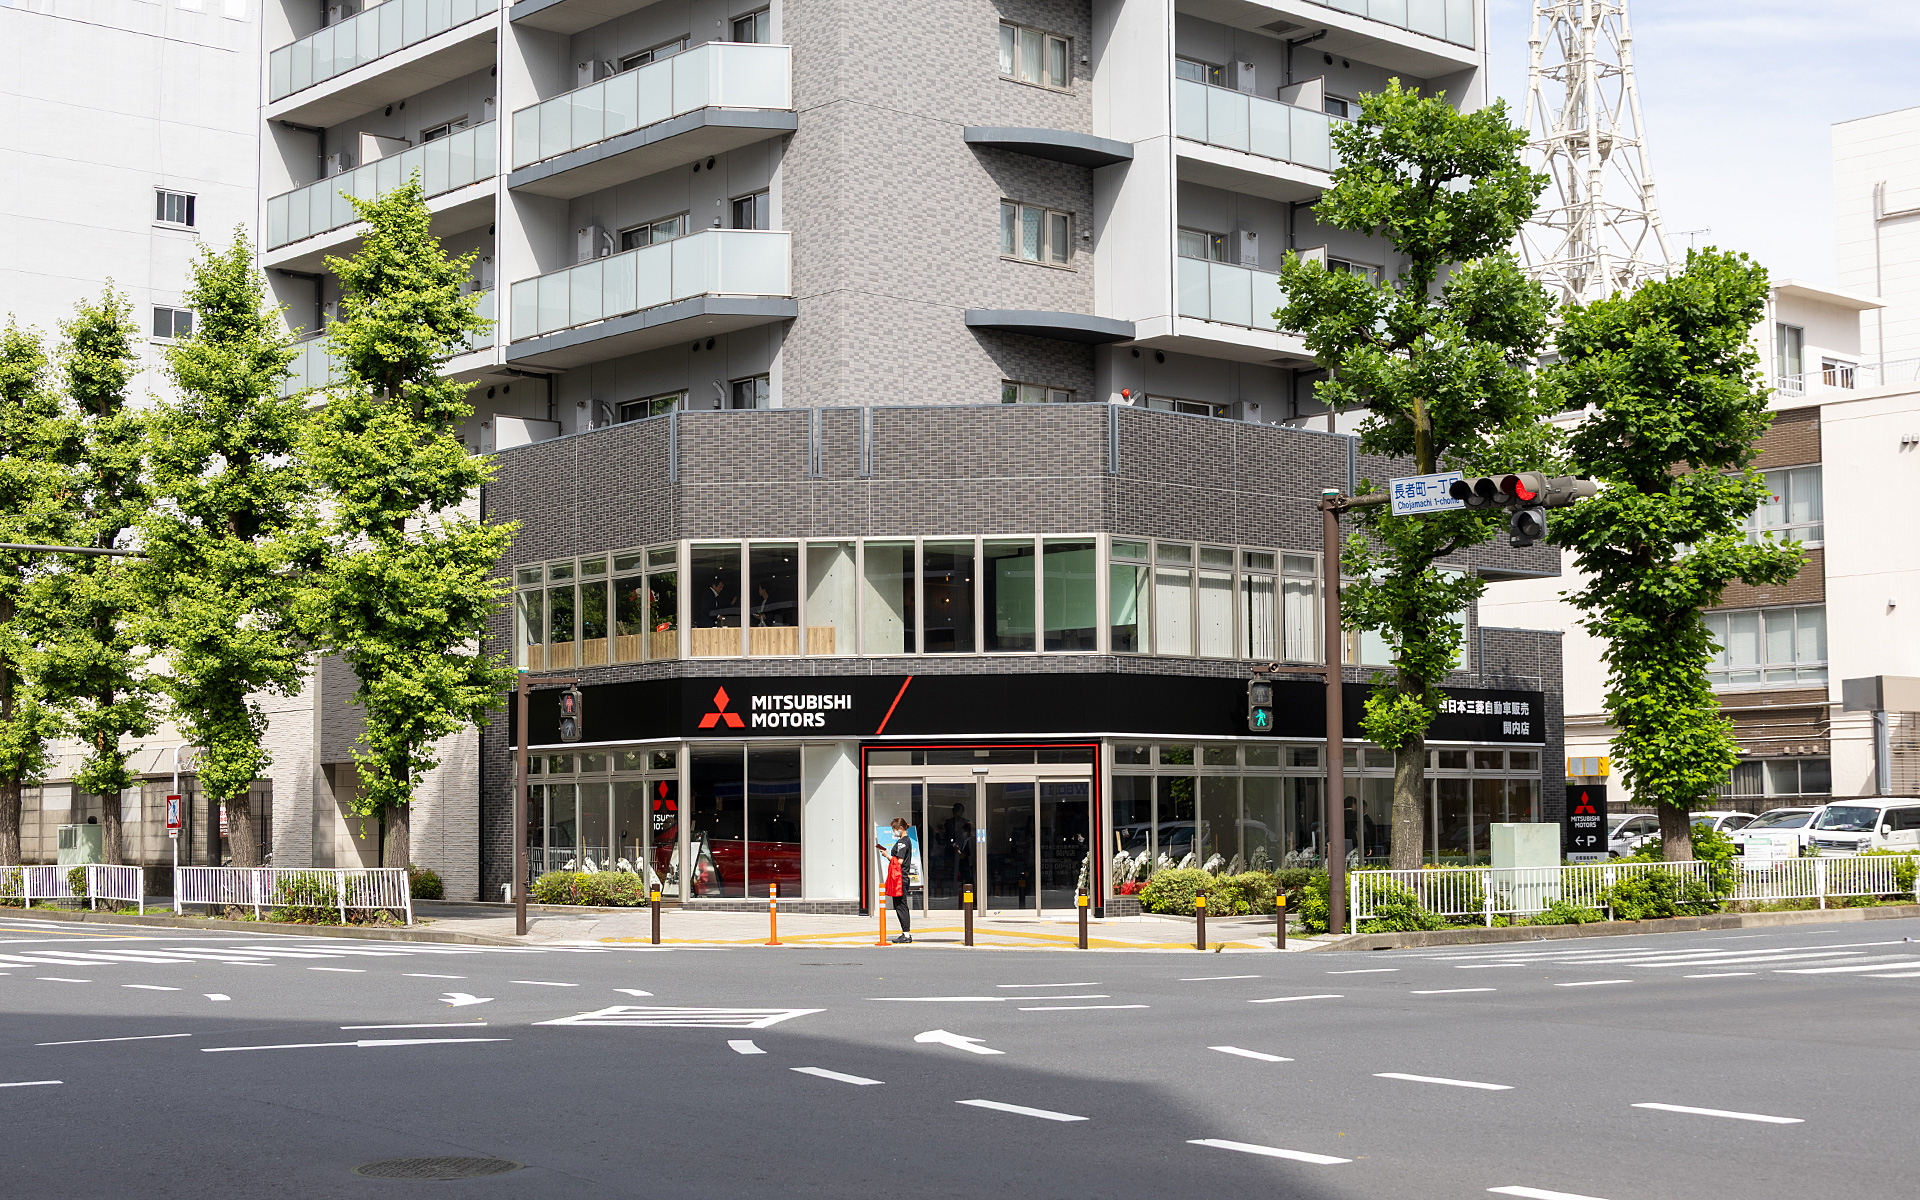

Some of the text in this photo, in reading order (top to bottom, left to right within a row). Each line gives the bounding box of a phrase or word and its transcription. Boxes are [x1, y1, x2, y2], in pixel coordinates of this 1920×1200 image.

[1398, 498, 1432, 510] Chojamachi
[751, 695, 852, 710] MITSUBISHI
[751, 712, 826, 728] MOTORS
[1503, 721, 1530, 735] 関内店
[1586, 835, 1597, 847] P
